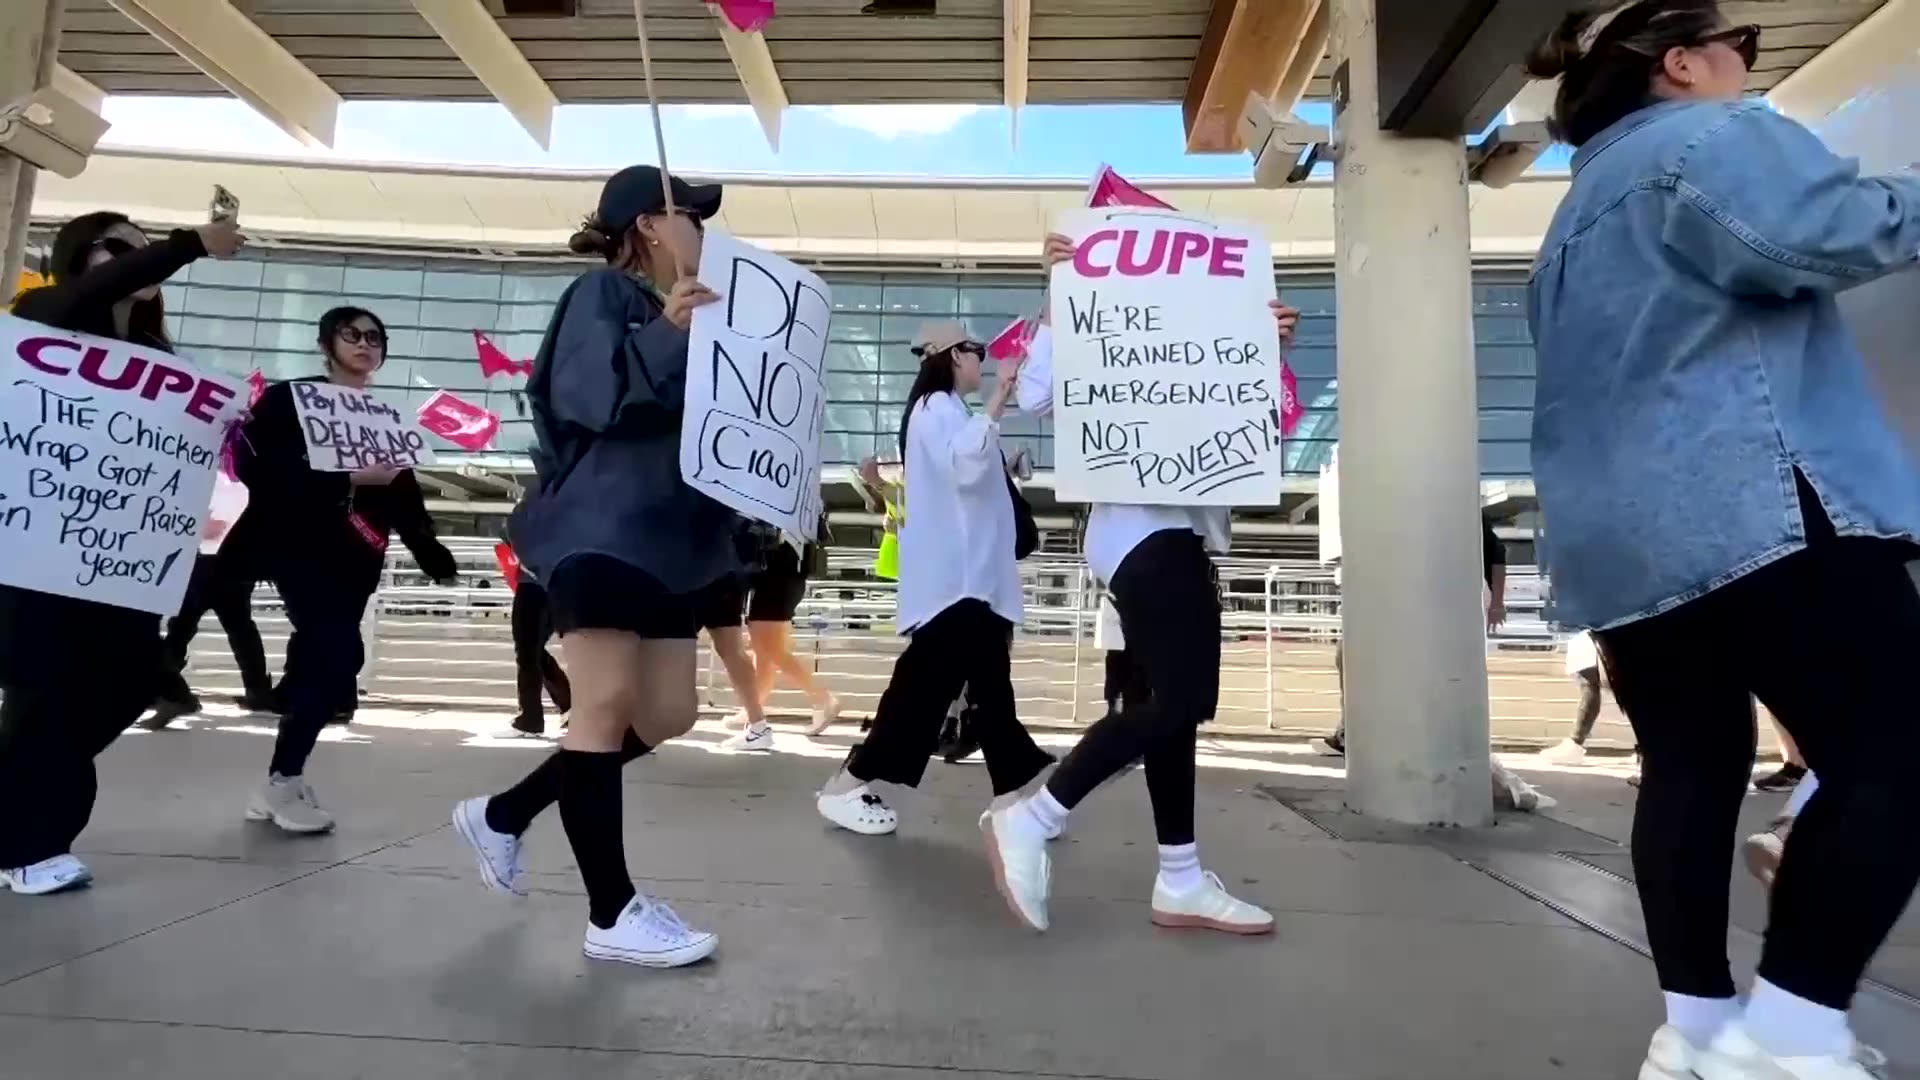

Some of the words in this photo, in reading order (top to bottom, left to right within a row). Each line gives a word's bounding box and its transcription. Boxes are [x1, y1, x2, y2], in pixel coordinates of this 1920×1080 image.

[1073, 230, 1248, 278] CUPE
[1068, 291, 1163, 334] WE'RE
[1086, 334, 1205, 368] TRAINED
[1214, 337, 1265, 367] FOR
[16, 336, 237, 425] CUPE
[713, 339, 802, 429] NO
[13, 379, 99, 430] THE
[108, 411, 214, 470] Chicken
[304, 414, 381, 450] DELAY
[385, 429, 424, 455] NO
[1081, 420, 1150, 455] NOT
[1130, 408, 1281, 488] POVERTY!
[0, 421, 89, 472] Wrap
[98, 454, 159, 488] Got
[160, 469, 182, 497] A
[60, 510, 138, 552] Four
[140, 495, 197, 537] Raise
